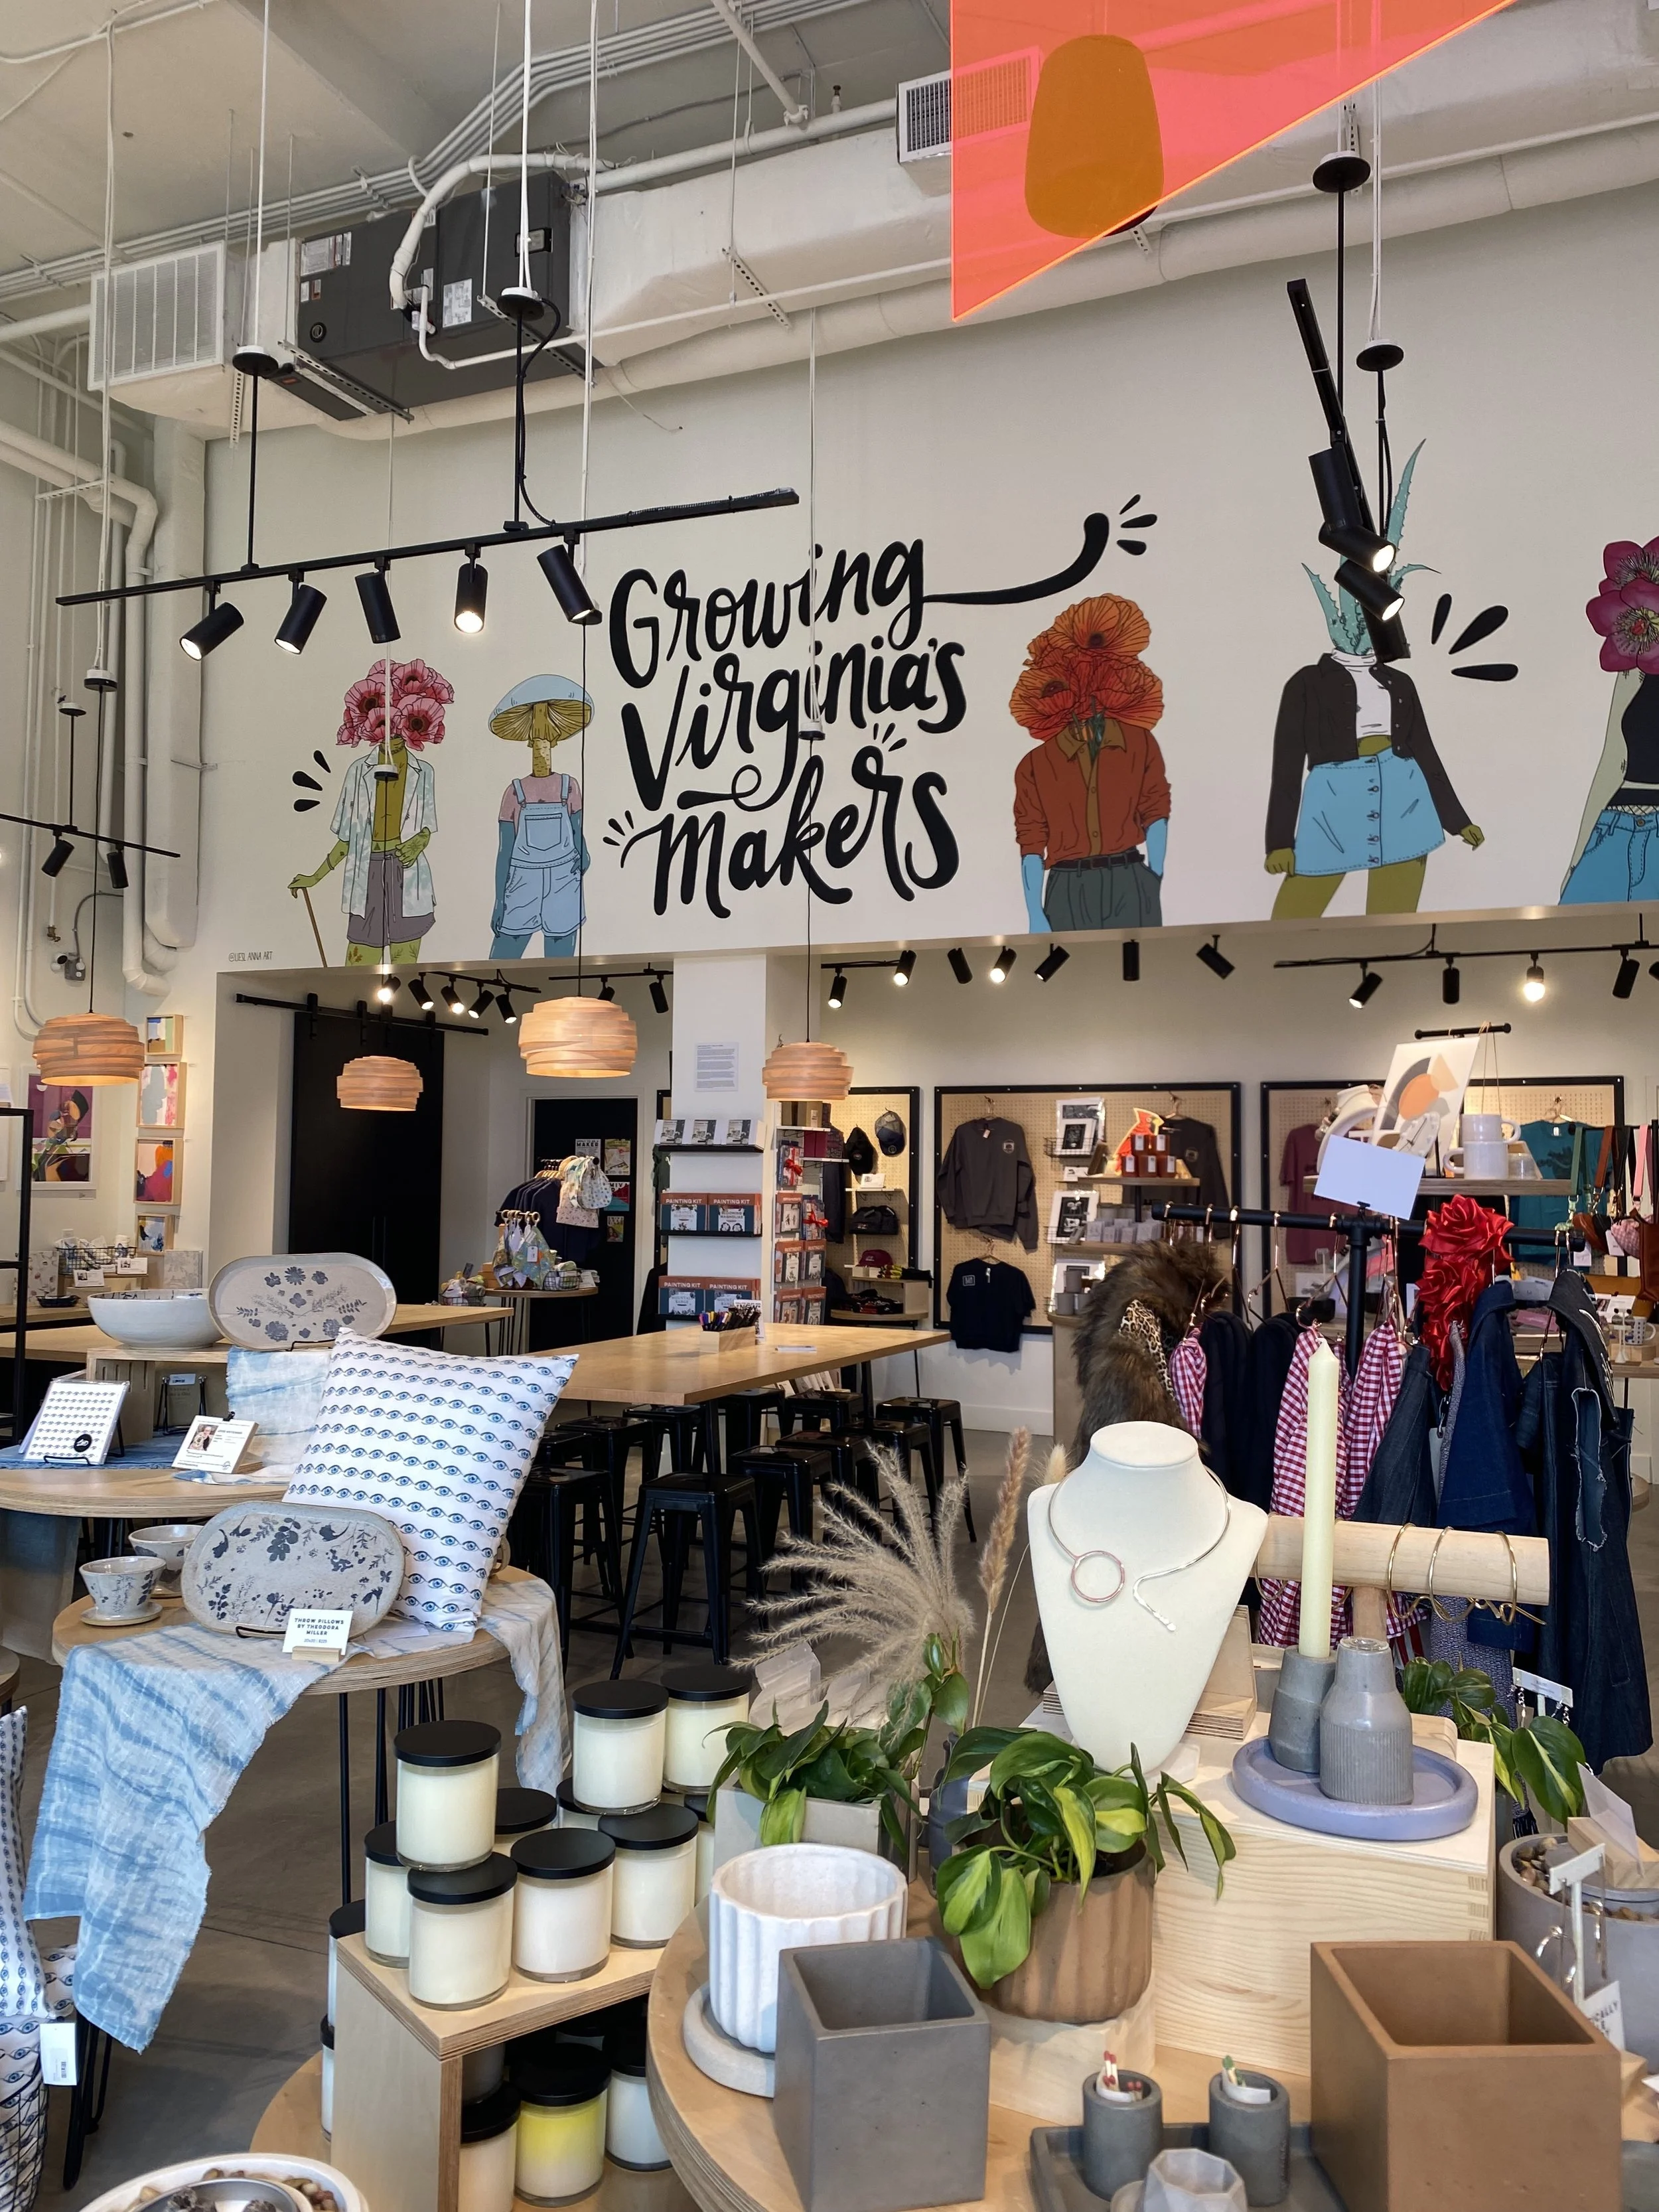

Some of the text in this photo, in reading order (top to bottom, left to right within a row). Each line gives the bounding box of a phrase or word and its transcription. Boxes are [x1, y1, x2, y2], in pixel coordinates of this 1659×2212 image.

[609, 536, 929, 688] Growing
[620, 635, 966, 812] Virginia's
[263, 951, 273, 960] ART
